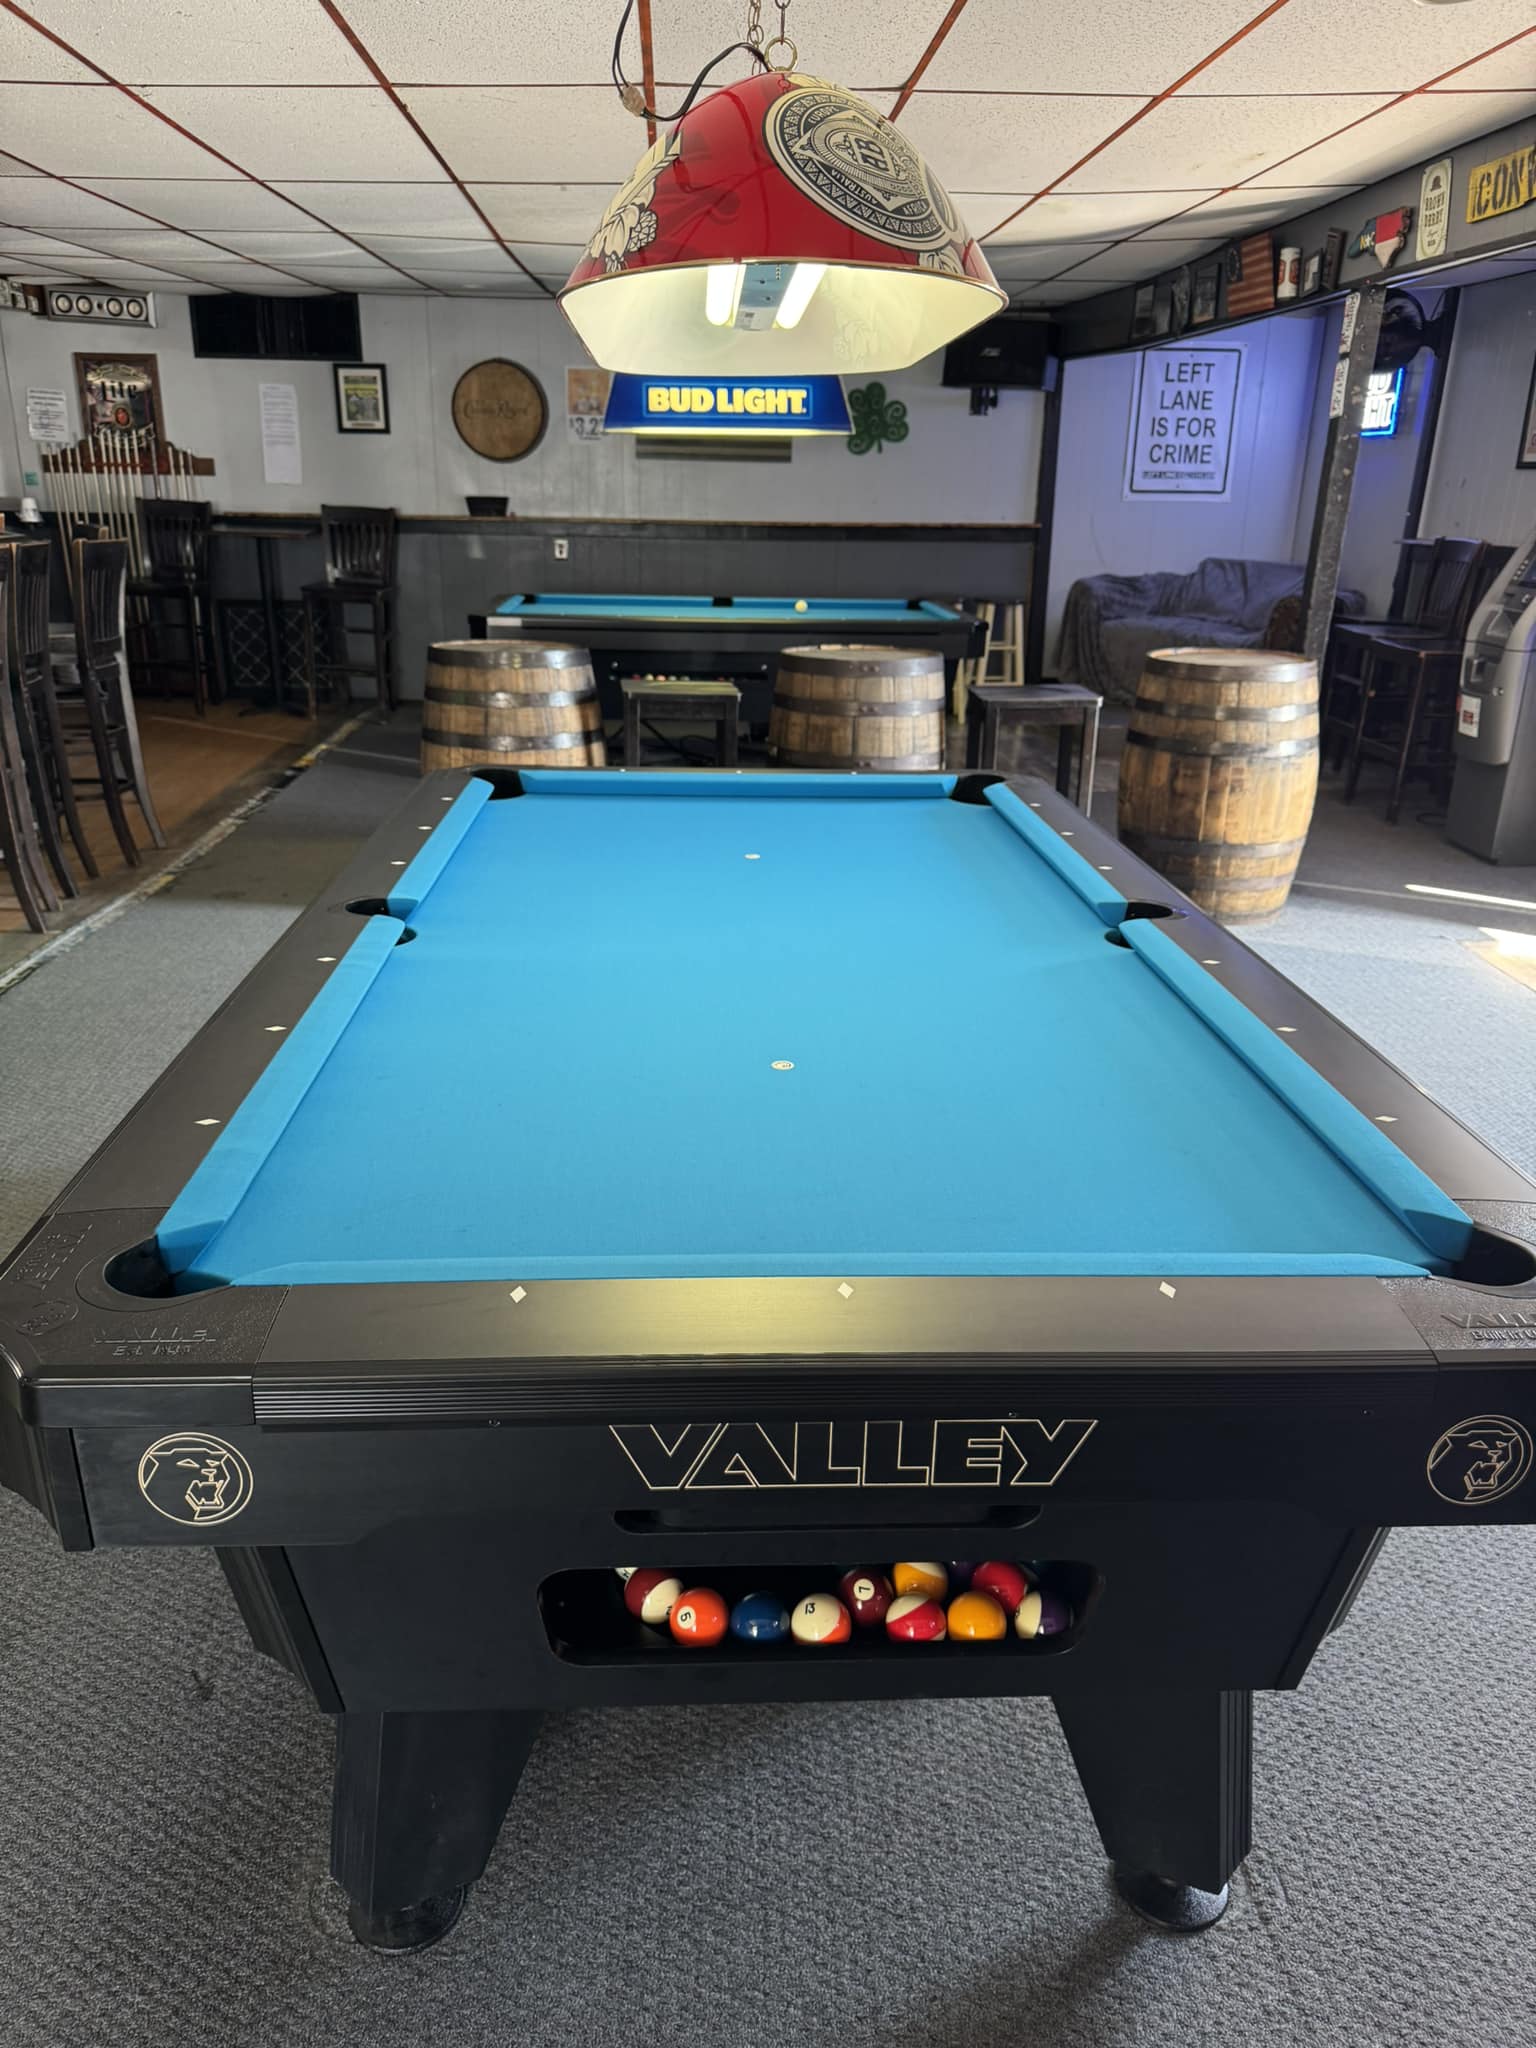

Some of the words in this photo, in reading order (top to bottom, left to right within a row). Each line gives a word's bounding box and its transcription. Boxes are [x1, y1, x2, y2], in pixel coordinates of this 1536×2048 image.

[807, 105, 840, 124] EUROPE
[831, 168, 878, 205] AUSTRALIA
[1164, 362, 1216, 383] LEFT
[648, 386, 715, 413] BUD
[1159, 390, 1214, 411] LANE
[1150, 417, 1169, 437] IS
[1175, 417, 1217, 438] FOR
[1149, 444, 1214, 464] CRIME
[1440, 1312, 1536, 1329] VALL
[609, 1419, 1100, 1490] VALLEY
[857, 1585, 871, 1594] 7
[679, 1610, 692, 1622] 5
[804, 1602, 816, 1614] 13
